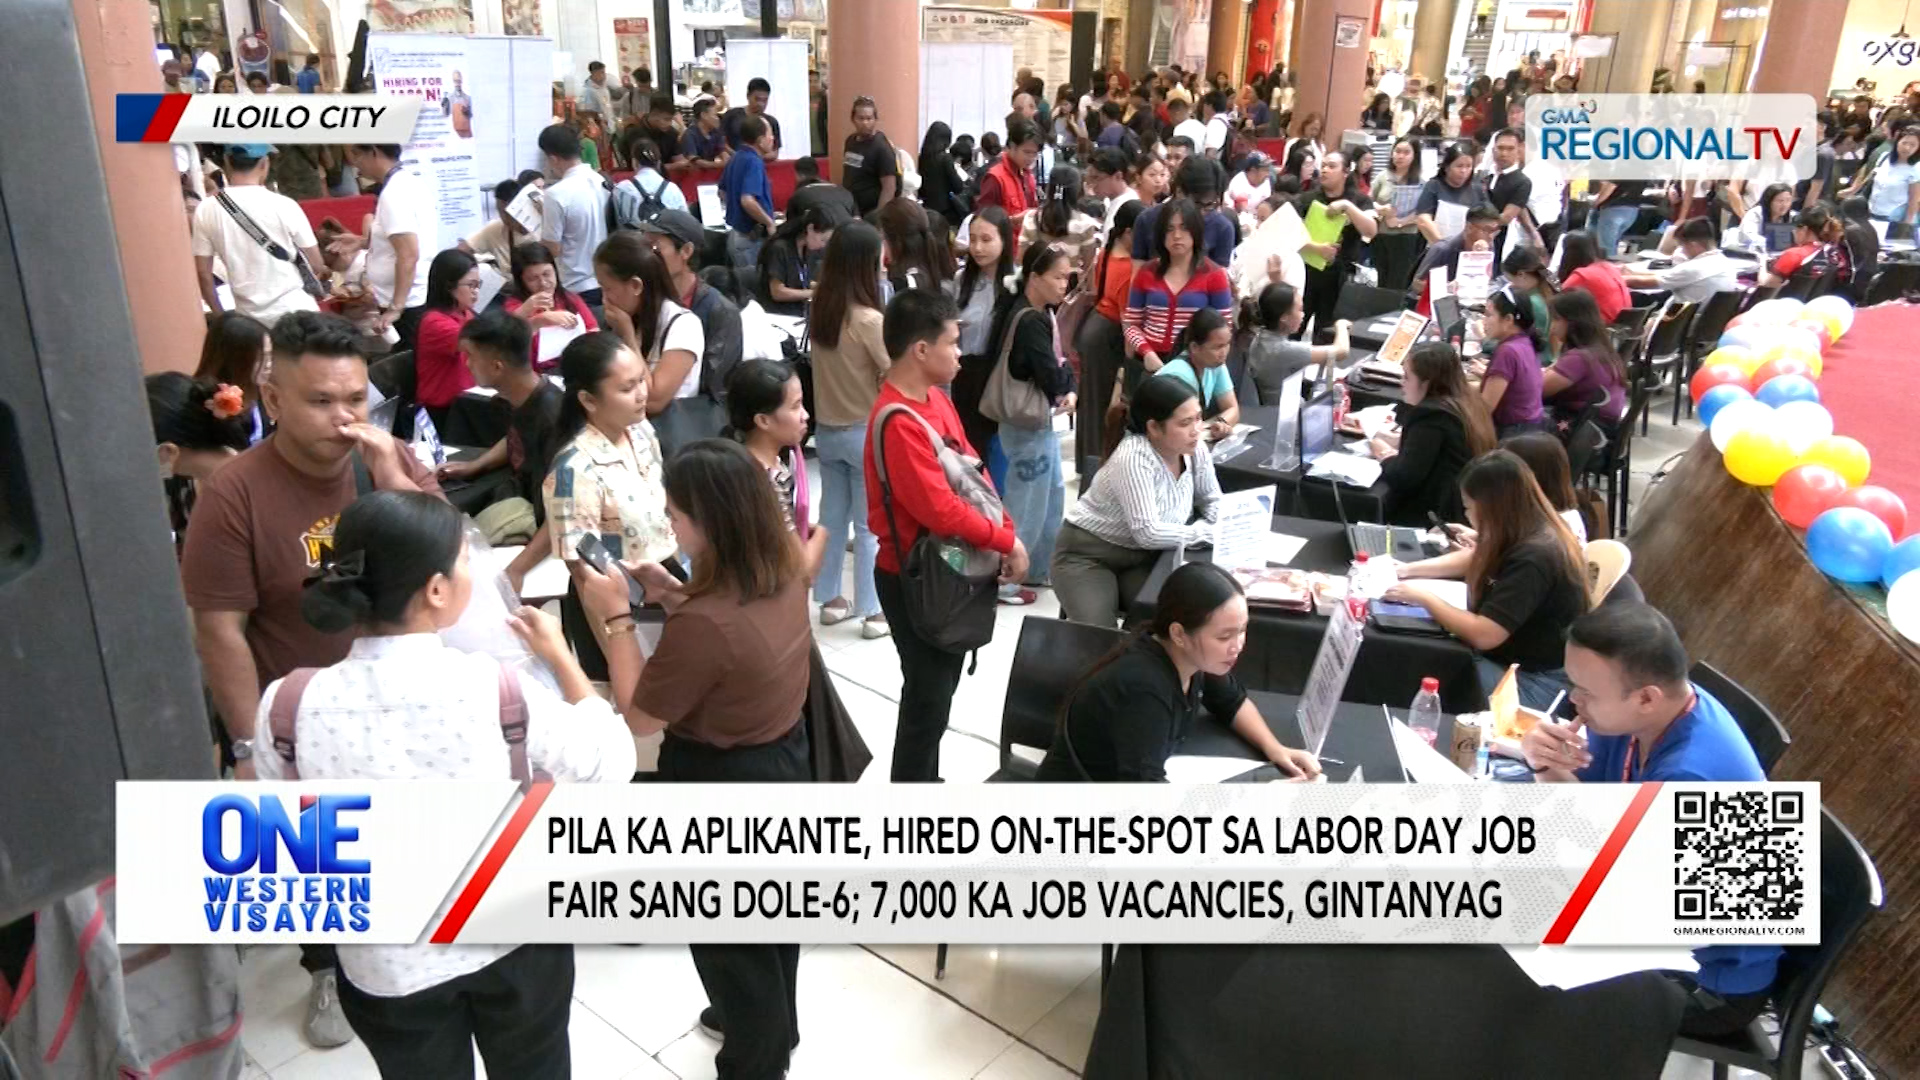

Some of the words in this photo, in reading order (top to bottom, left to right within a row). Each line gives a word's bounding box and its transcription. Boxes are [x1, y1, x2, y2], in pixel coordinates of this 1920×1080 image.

[1863, 40, 1920, 66] oxg
[383, 77, 418, 87] HIRING
[421, 77, 443, 86] FOR
